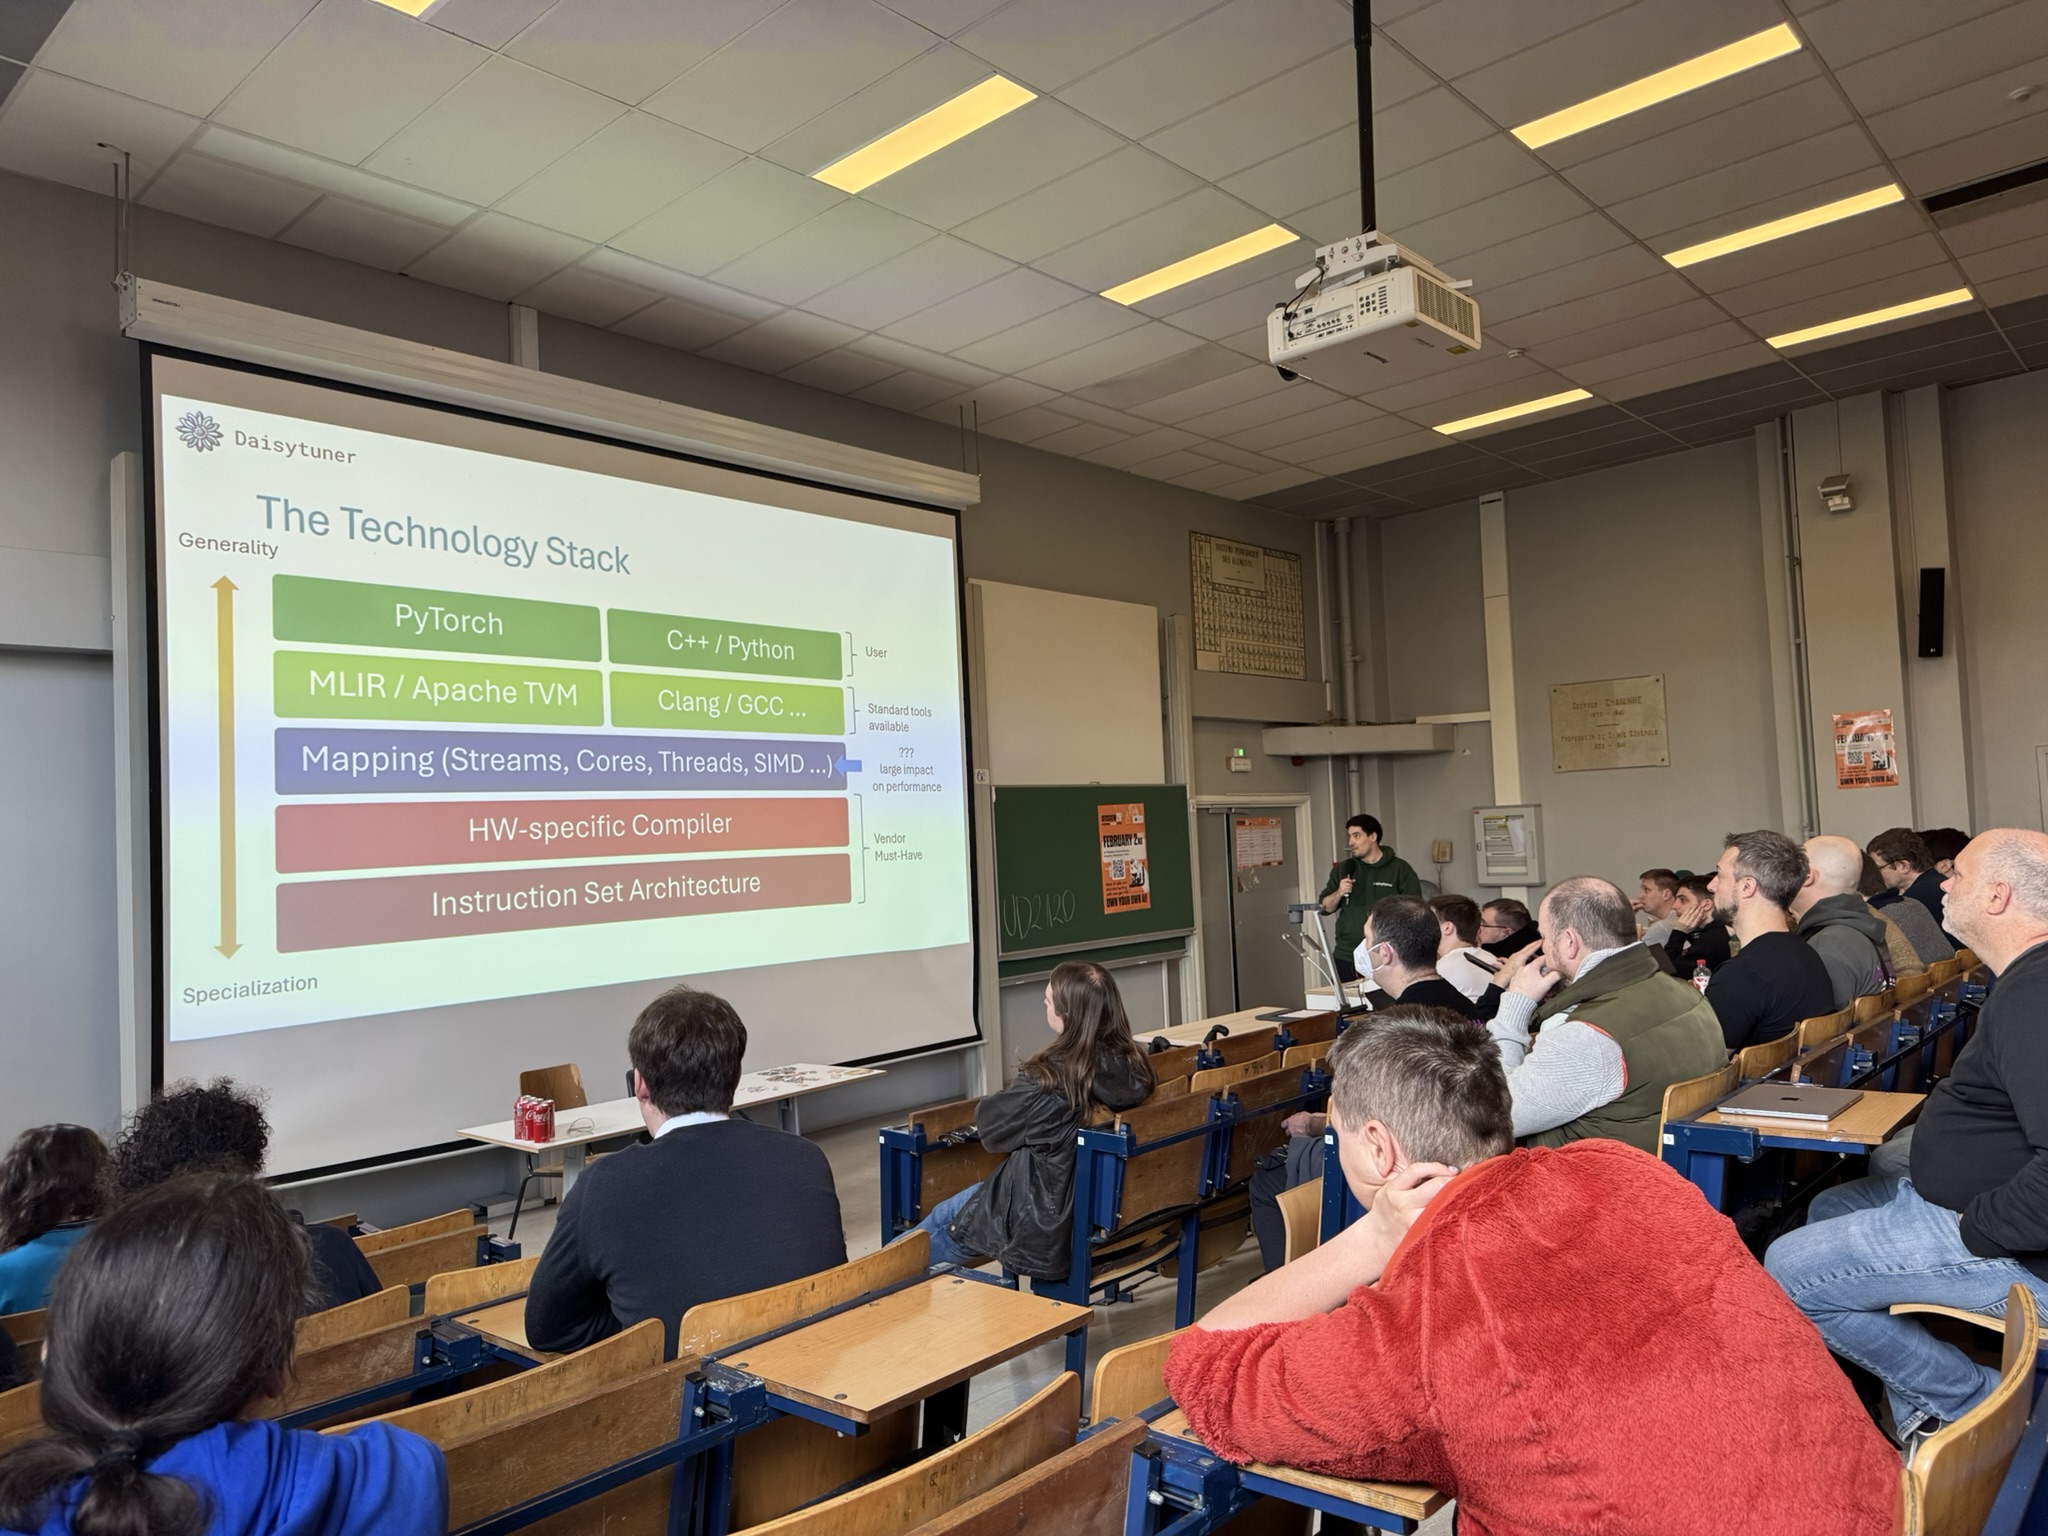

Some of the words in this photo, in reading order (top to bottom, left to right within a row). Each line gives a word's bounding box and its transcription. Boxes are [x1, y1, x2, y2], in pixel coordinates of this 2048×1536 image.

[234, 429, 357, 464] Daisytuner
[178, 532, 279, 560] Generality
[256, 494, 330, 537] The
[340, 506, 538, 569] Technology
[546, 536, 631, 575] Stack
[395, 603, 503, 635] PyTorch
[667, 629, 710, 651] C++
[715, 633, 723, 655] /
[728, 634, 795, 661] Python
[865, 646, 888, 659] User
[309, 670, 386, 698] MLIR
[393, 674, 405, 699] /
[412, 675, 517, 706] Apache
[523, 681, 578, 706] TVM
[658, 689, 721, 718] Clang
[725, 693, 733, 714] /
[737, 693, 785, 716] GCC
[867, 702, 909, 717] Standard
[911, 705, 933, 718] tools
[869, 720, 909, 733] available
[302, 745, 435, 778] Mapping
[442, 747, 570, 777] (Streams,
[576, 749, 653, 776] Cores,
[658, 751, 749, 776] Threads,
[754, 753, 805, 774] SIMD
[898, 747, 915, 758] ???
[879, 763, 902, 777] large
[903, 764, 935, 777] impact
[872, 783, 885, 793] on
[886, 781, 942, 794] performance
[469, 814, 625, 845] HW-specific
[631, 812, 732, 839] Compiler
[874, 833, 906, 845] Vendor
[1103, 833, 1132, 848] FEBRUARY
[875, 849, 923, 863] Must-Have
[432, 884, 577, 916] Instruction
[584, 881, 624, 905] Set
[629, 874, 761, 901] Architecture
[183, 976, 318, 1007] Specialization
